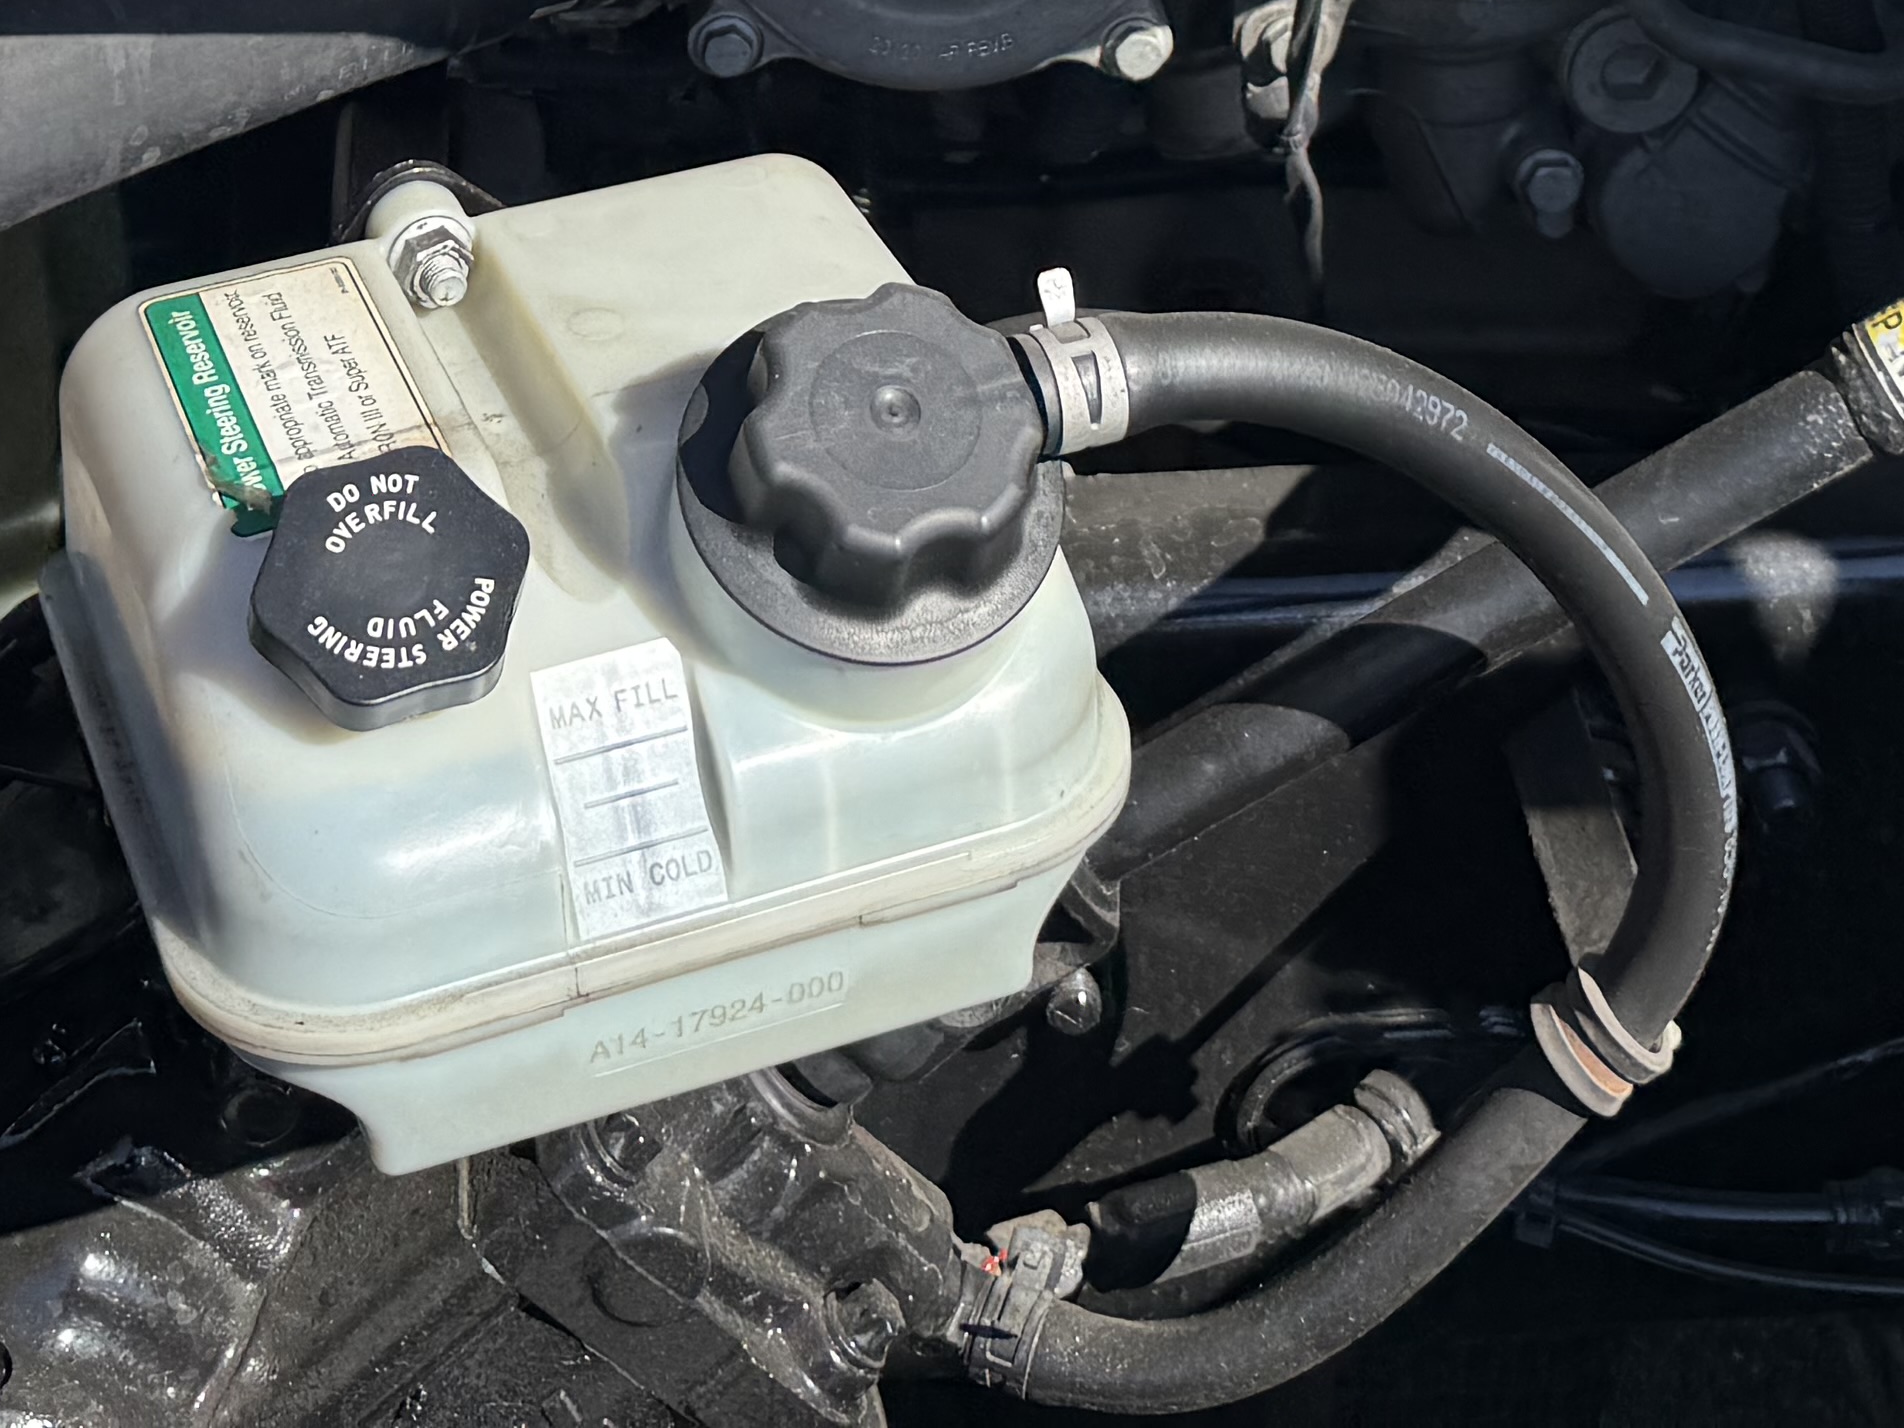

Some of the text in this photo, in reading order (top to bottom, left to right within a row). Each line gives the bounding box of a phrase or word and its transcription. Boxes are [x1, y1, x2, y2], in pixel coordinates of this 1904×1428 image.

[168, 309, 218, 386] Reservoir
[247, 335, 267, 360] on
[282, 315, 328, 401] Transmission
[323, 333, 350, 355] ATF
[252, 359, 281, 393] mark
[341, 358, 369, 393] Super
[358, 393, 377, 408] or
[204, 383, 247, 456] Steering
[270, 394, 315, 461] appropriate
[316, 401, 356, 461] Automatic
[326, 474, 419, 512] DO NOT
[325, 500, 437, 554] OVERFILL
[307, 577, 495, 669] POWER STEERING
[366, 599, 449, 640] FLUID
[548, 677, 679, 731] MAX FILL
[583, 847, 713, 905] MIN COLD
[589, 969, 845, 1064] A14-17924-000
